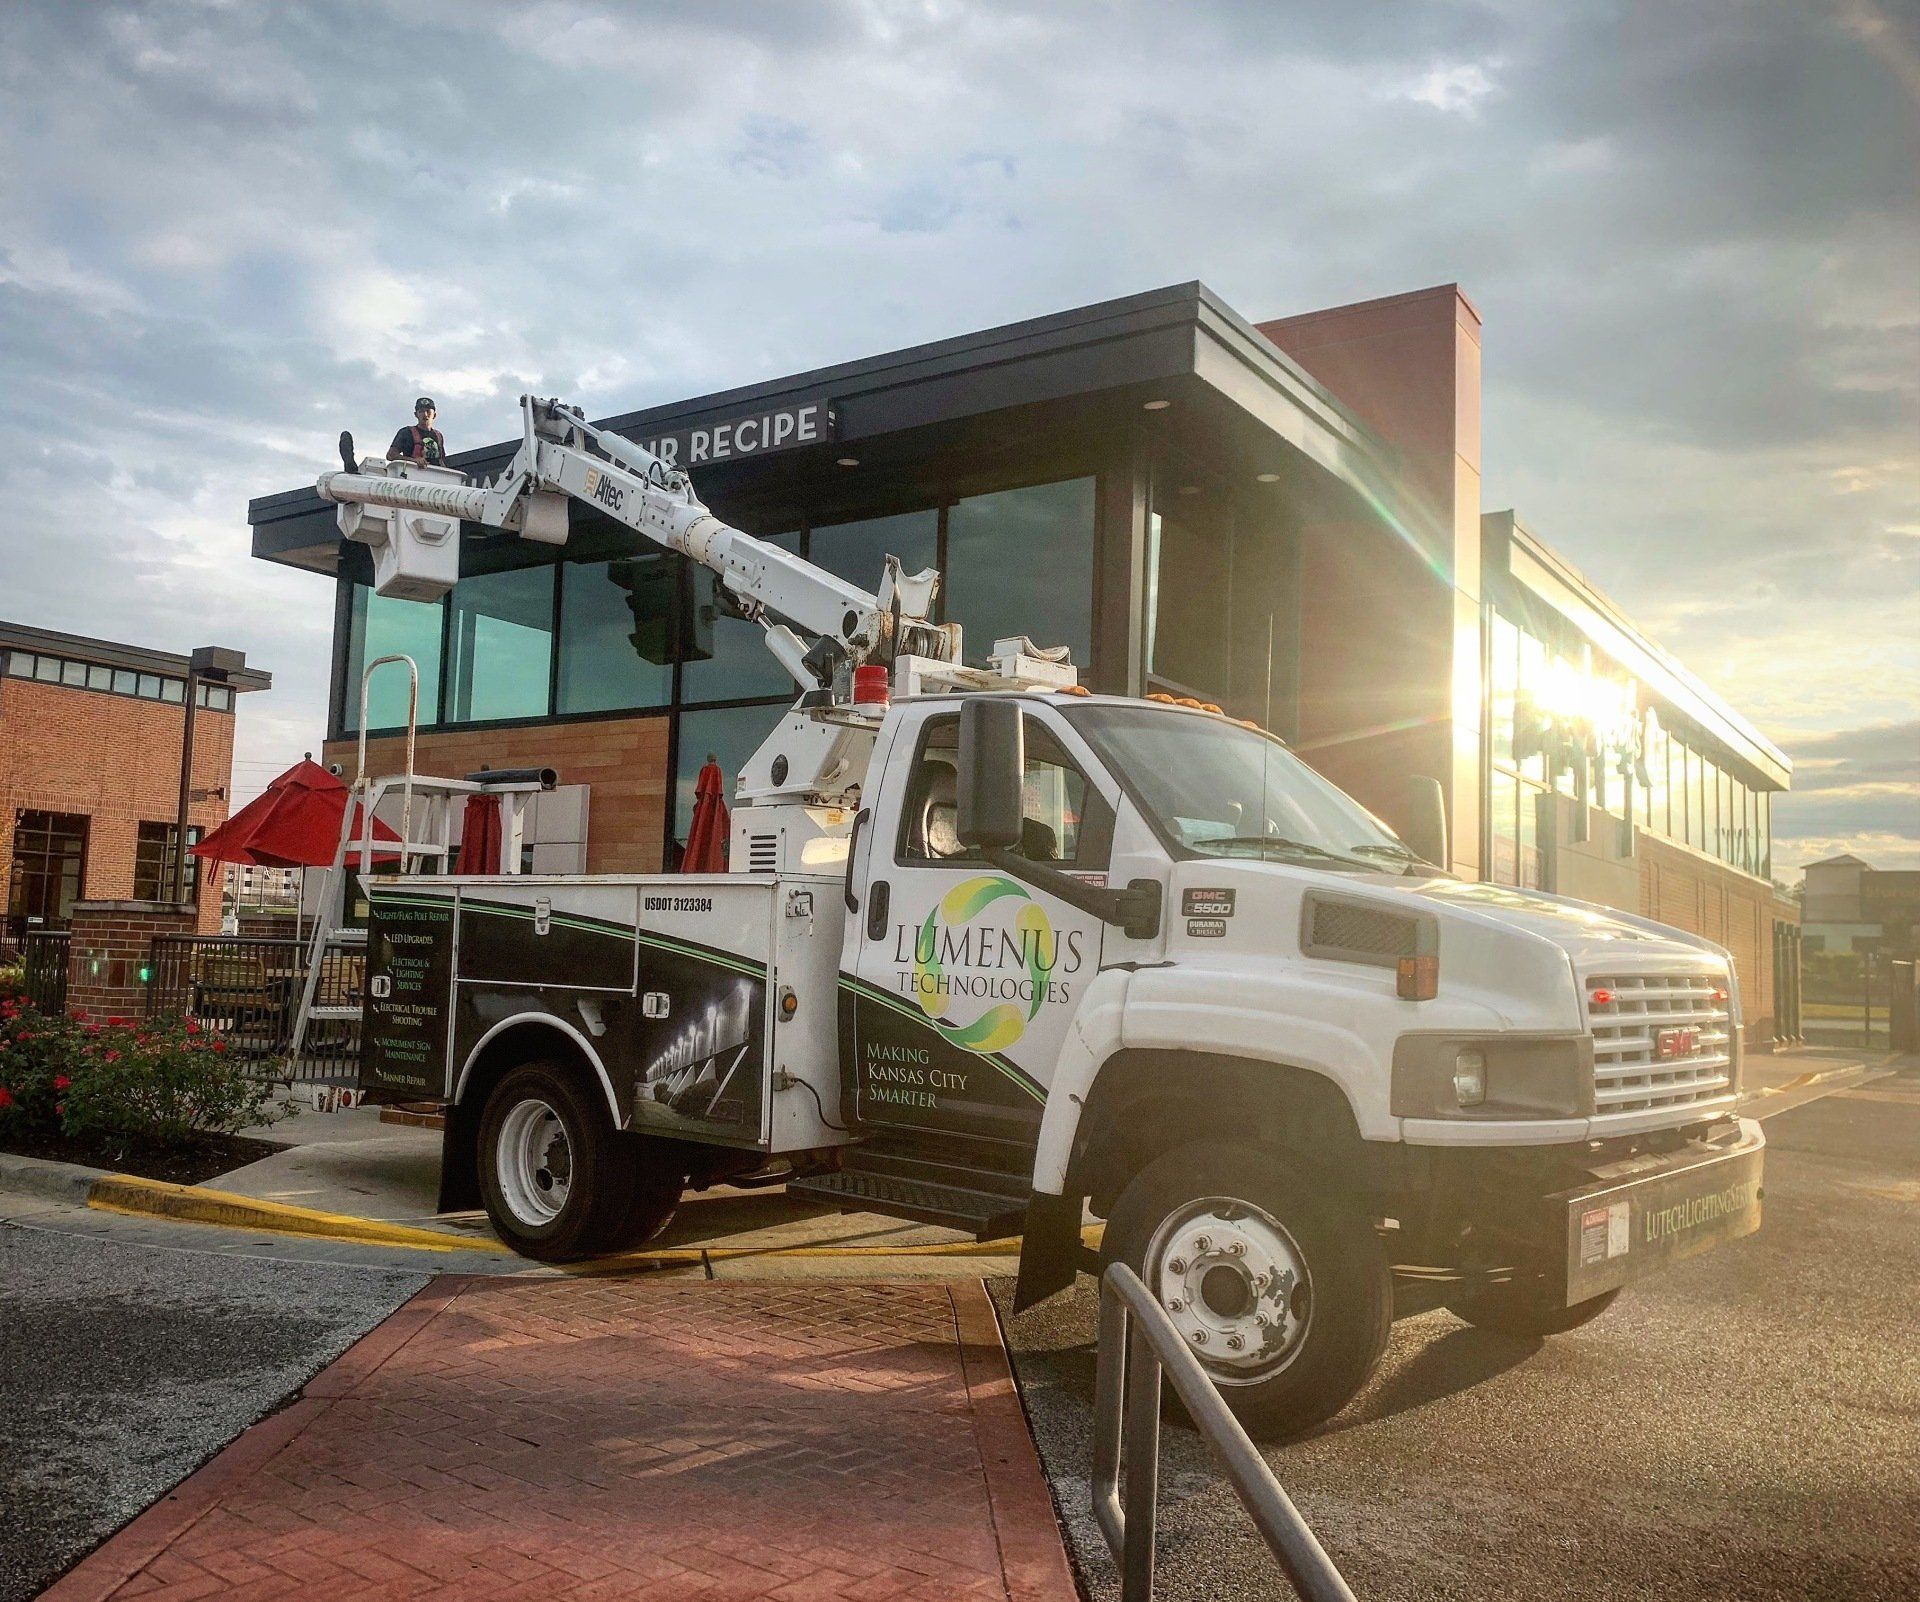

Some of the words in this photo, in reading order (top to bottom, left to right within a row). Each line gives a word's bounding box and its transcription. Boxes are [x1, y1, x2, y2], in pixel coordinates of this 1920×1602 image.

[690, 405, 818, 463] RECIPE
[593, 474, 624, 511] Altec
[1191, 891, 1226, 900] GMC
[644, 896, 673, 911] USDOT
[674, 897, 713, 912] 3123384
[414, 911, 428, 921] POLE
[429, 911, 450, 922] REPAIR
[391, 933, 404, 944] LED
[404, 933, 434, 945] UPGRADES
[893, 924, 1084, 973] LUMENUS
[392, 956, 423, 968] ELECTRICAL
[396, 968, 425, 980] LIGHTING
[397, 980, 422, 991] SERVICES
[896, 971, 1070, 1004] TECHNOLOGIES
[380, 1001, 411, 1014] ELECTRICAL
[411, 1004, 438, 1016] TROUBLE
[392, 1014, 423, 1027] SHOOTING
[381, 1037, 416, 1050] MONUMENT
[416, 1039, 431, 1051] SIGN
[385, 1049, 426, 1063] MAINTENANCE
[867, 1042, 930, 1065] MAKING
[383, 1071, 406, 1084] BANNER
[406, 1074, 427, 1087] REPAIR
[867, 1062, 924, 1085] KANSAS
[929, 1069, 968, 1091] CITY
[869, 1083, 938, 1109] SMARTER
